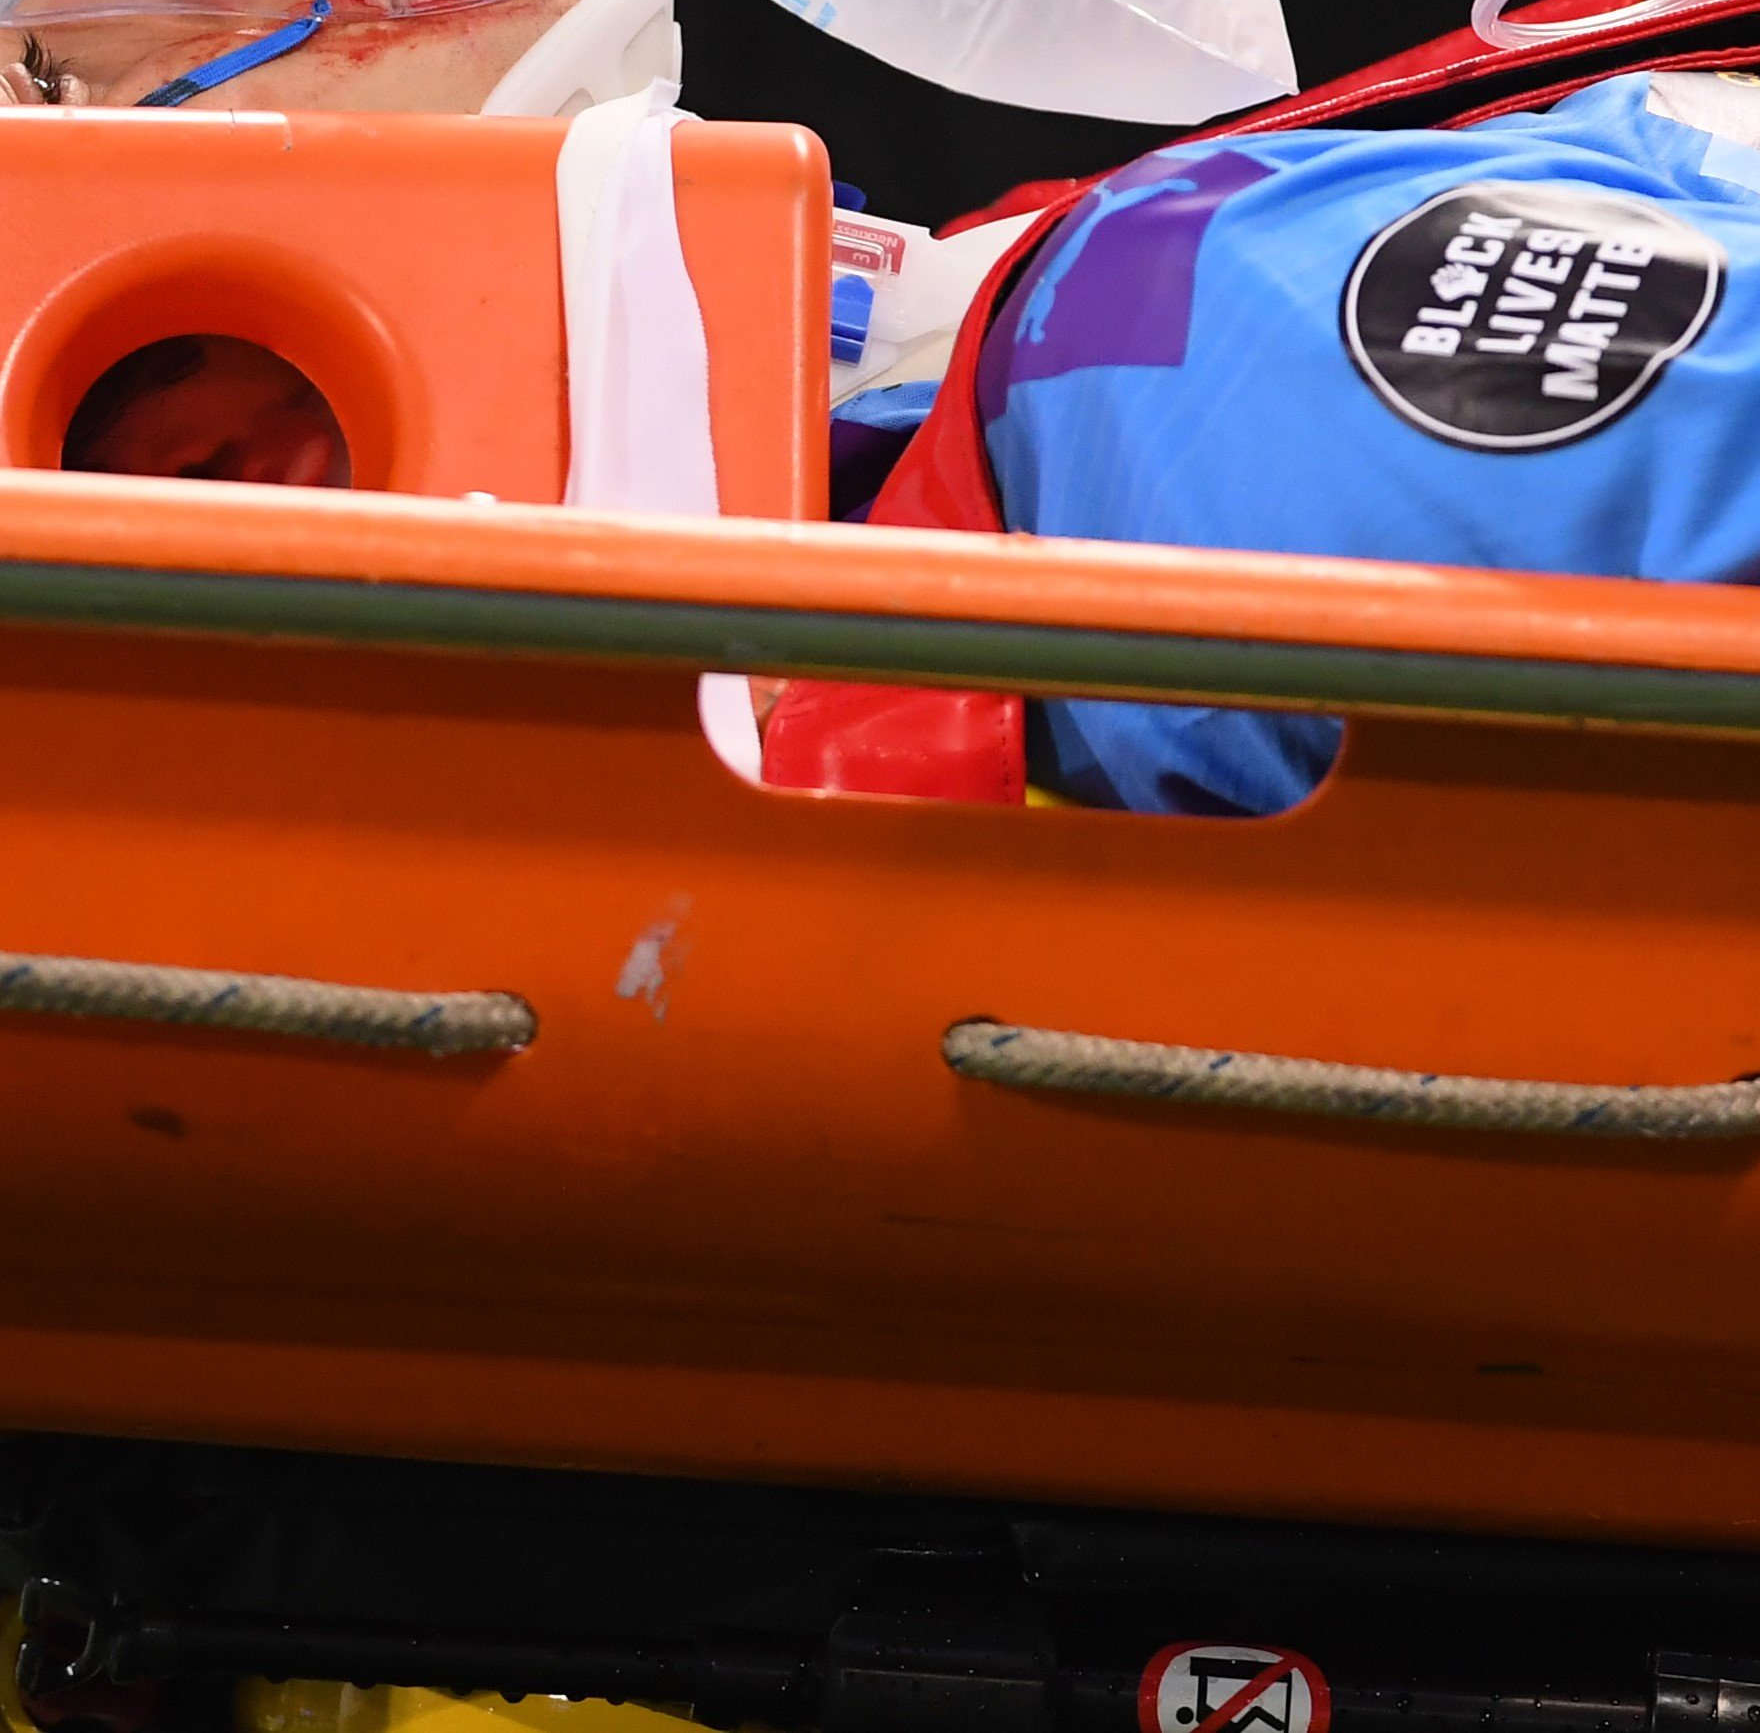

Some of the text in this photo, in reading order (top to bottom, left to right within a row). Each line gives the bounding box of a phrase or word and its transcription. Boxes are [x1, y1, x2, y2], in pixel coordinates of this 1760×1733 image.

[852, 252, 870, 264] 3
[1475, 229, 1586, 354] LIVES
[1542, 230, 1655, 401] MATTE
